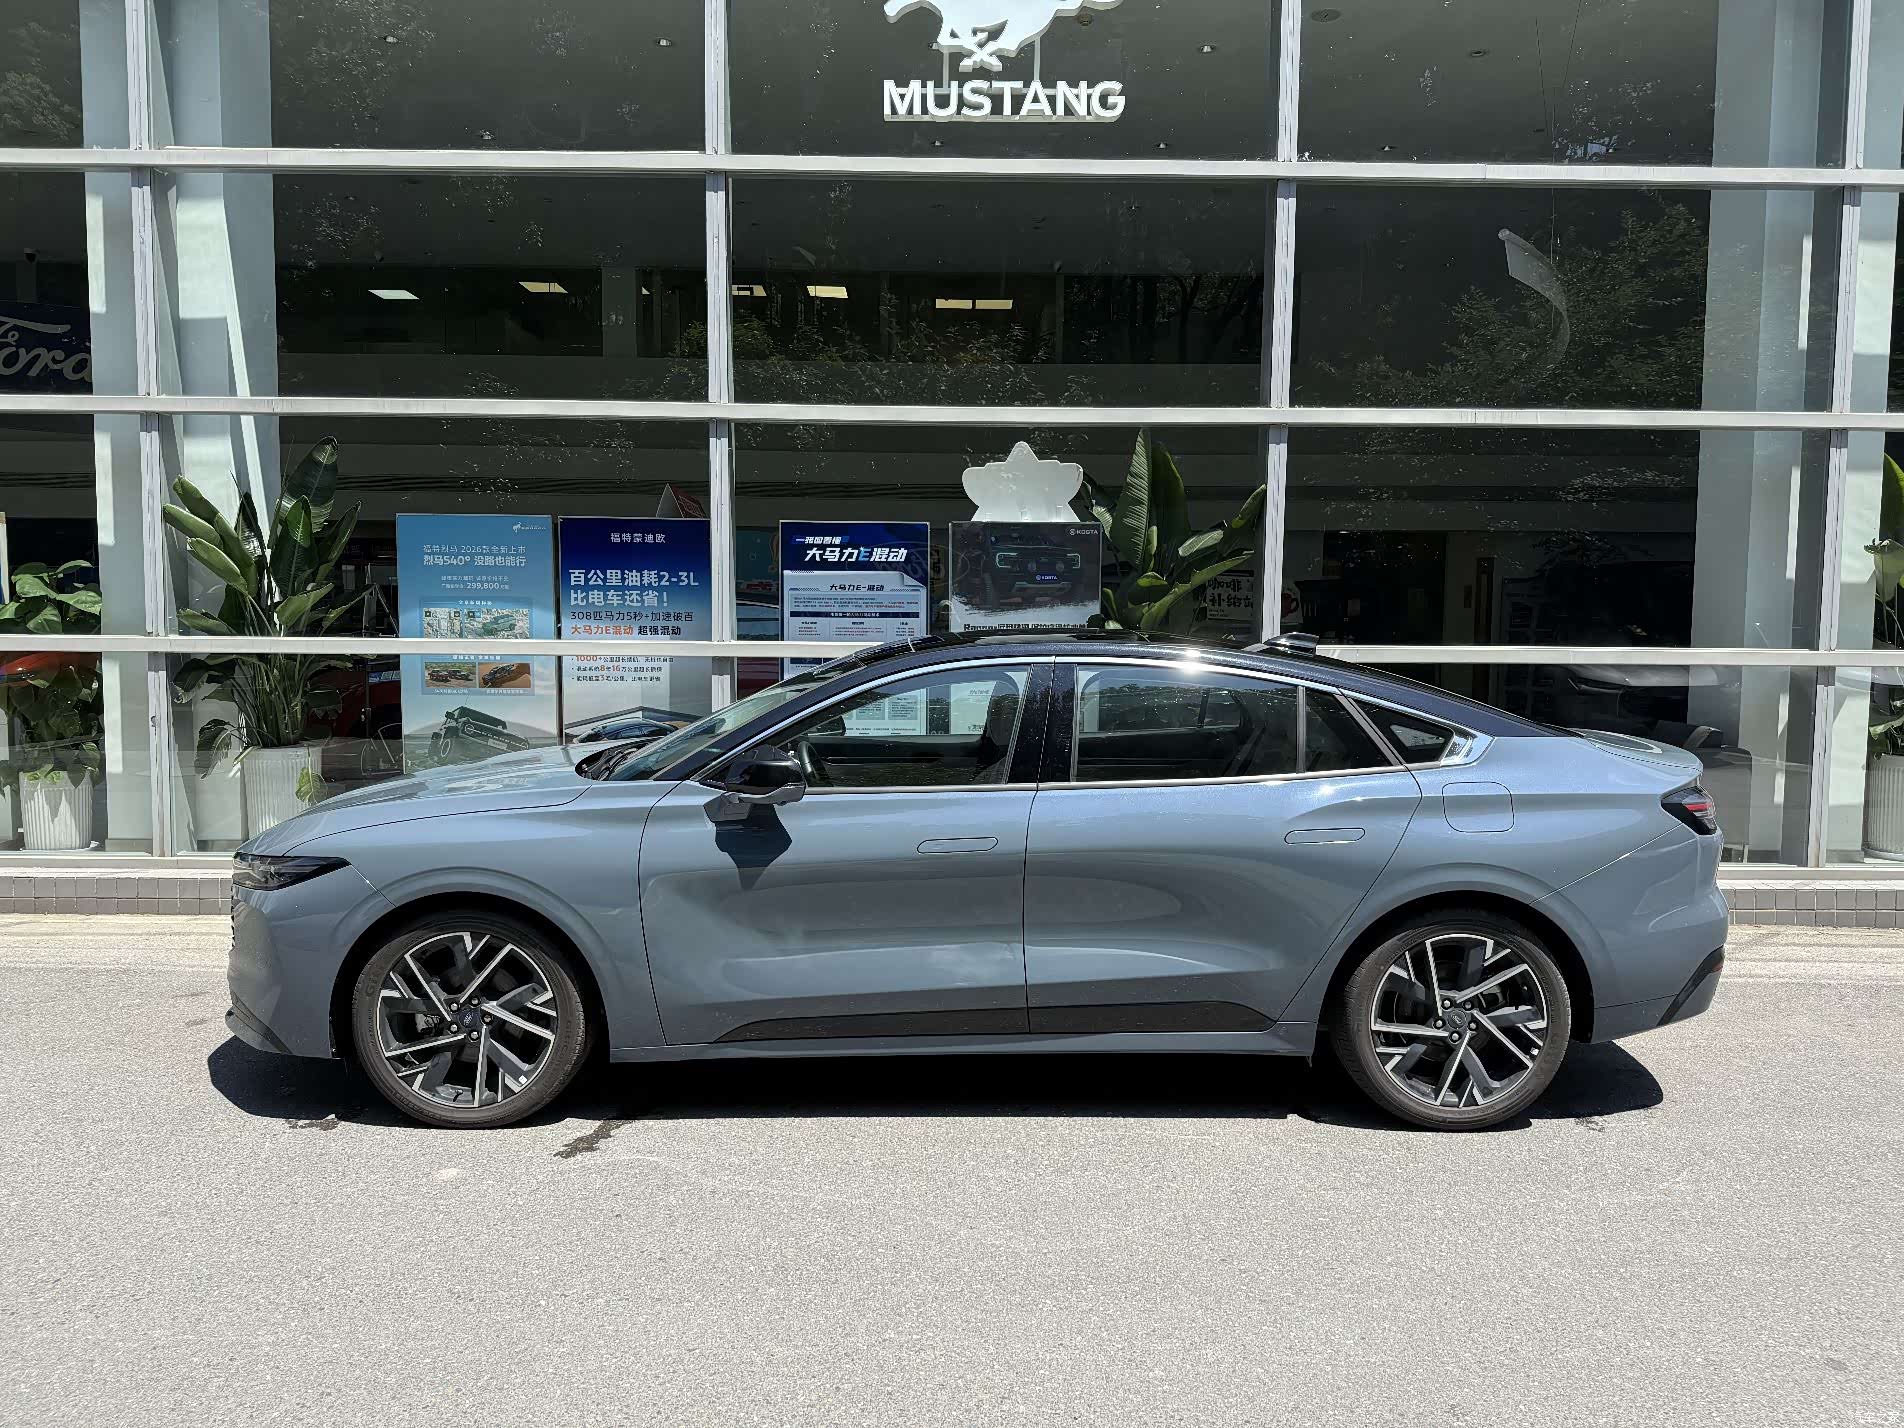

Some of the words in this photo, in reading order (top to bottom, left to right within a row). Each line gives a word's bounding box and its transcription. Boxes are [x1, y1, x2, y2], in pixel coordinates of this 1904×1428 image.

[883, 79, 1126, 120] MUSTANG
[610, 532, 666, 543] 福特蒙迪欧
[423, 544, 458, 553] 福特烈马
[461, 545, 526, 554] 2026款全新上市
[804, 546, 908, 562] 大马力E混动
[423, 554, 471, 566] 烈马540°
[474, 555, 527, 567] 没路也能行
[568, 569, 700, 587] 百公里油耗2-3L
[829, 584, 885, 592] 大马力E-混动
[570, 589, 668, 607] 比电车还省！
[570, 611, 694, 622] 308匹马力5秒+加速破百
[571, 625, 634, 635] 大马力E混动
[637, 625, 681, 636] 超强混动
